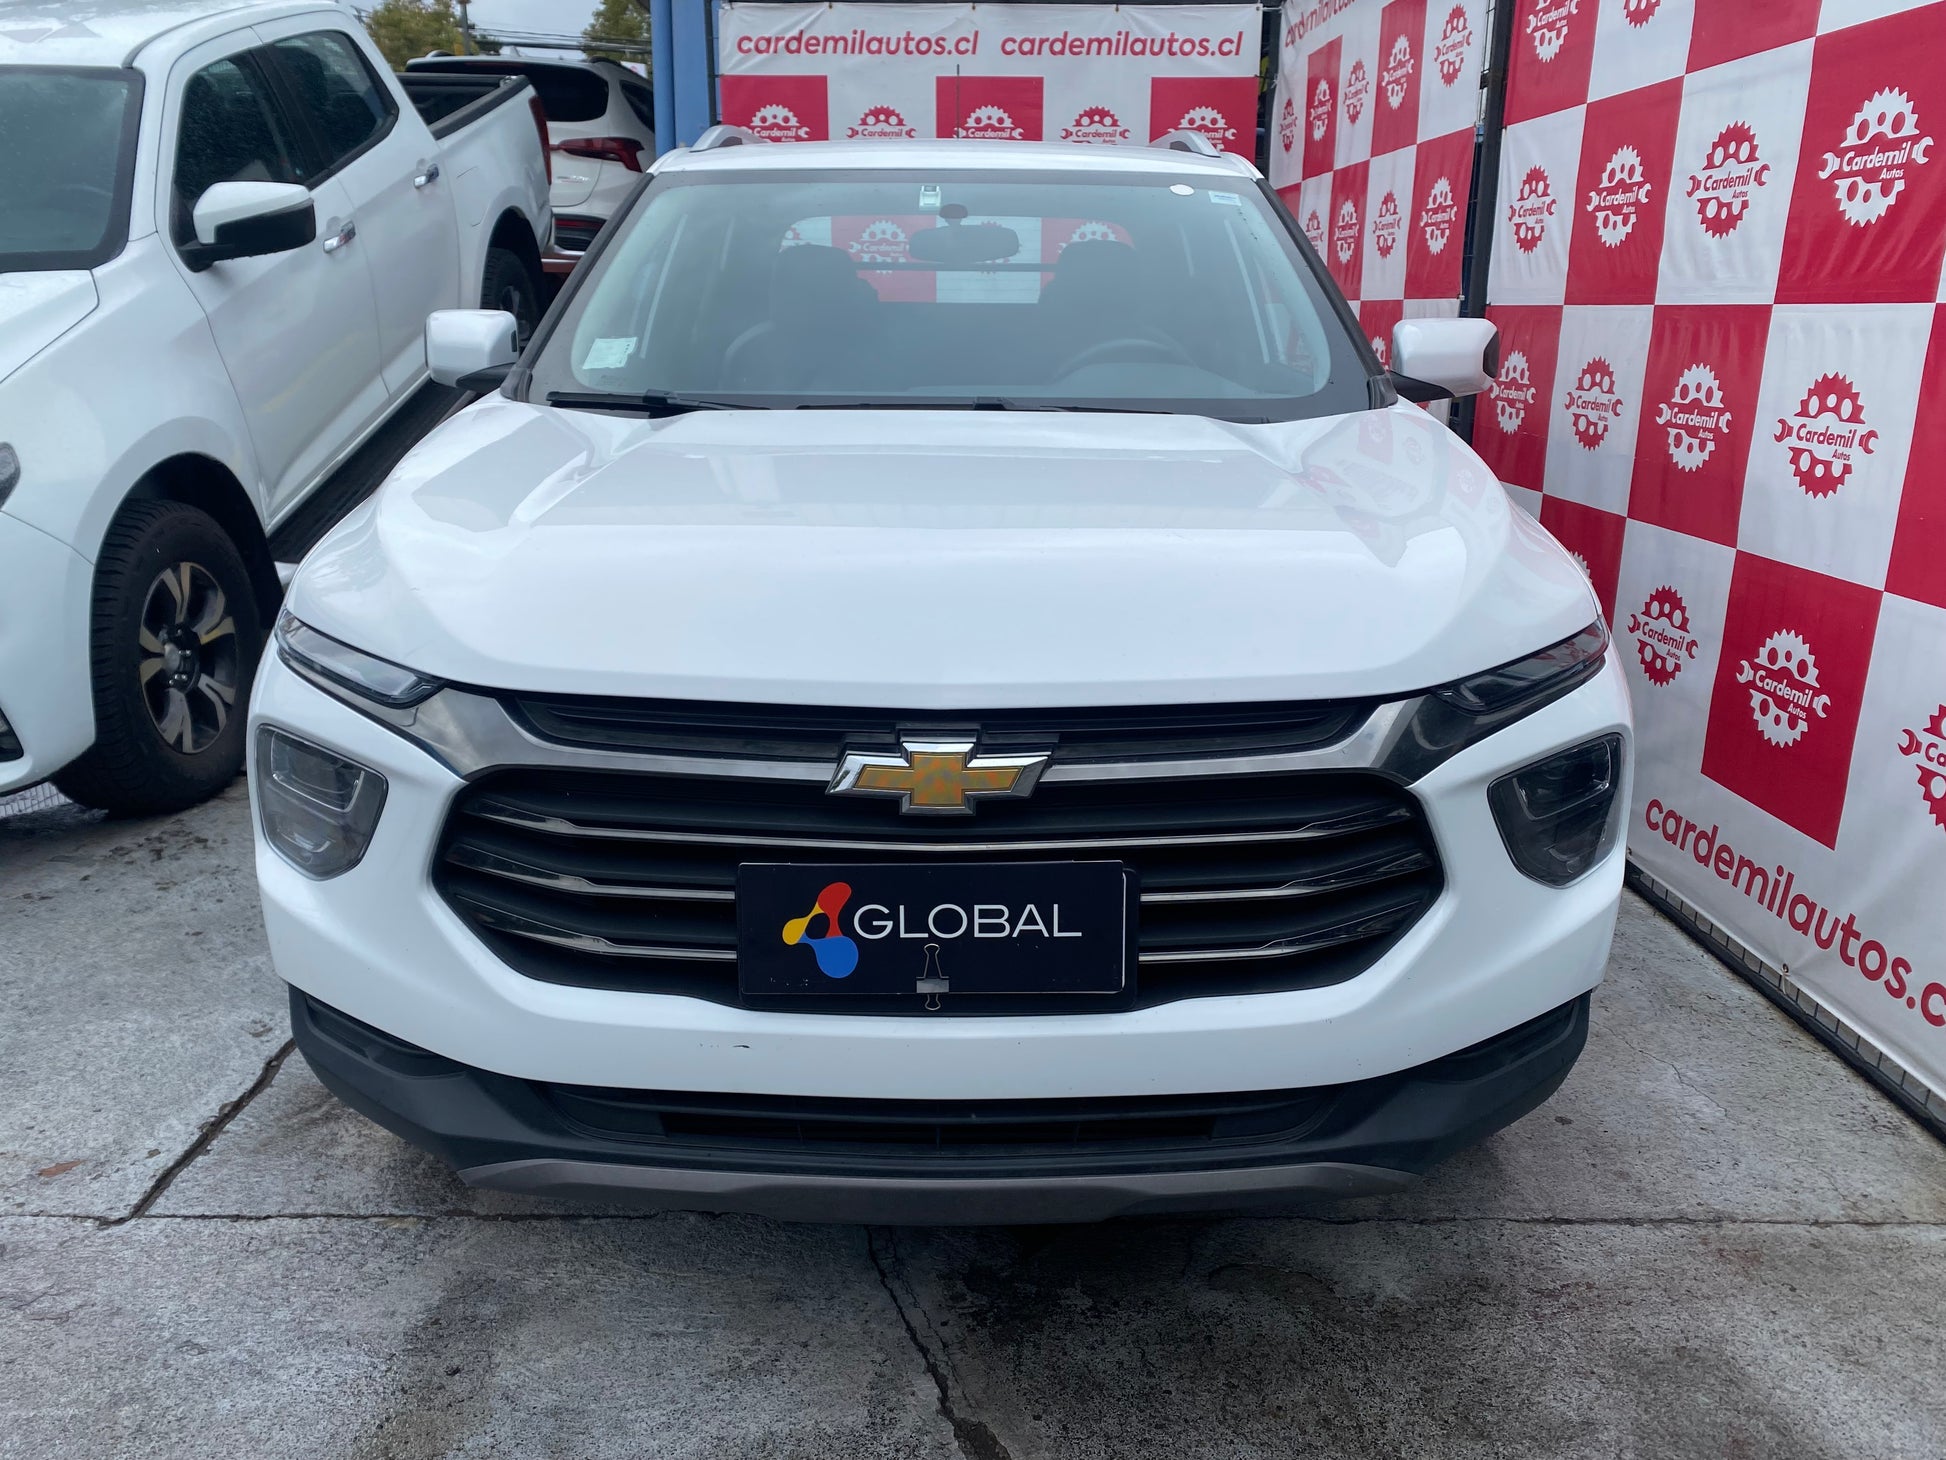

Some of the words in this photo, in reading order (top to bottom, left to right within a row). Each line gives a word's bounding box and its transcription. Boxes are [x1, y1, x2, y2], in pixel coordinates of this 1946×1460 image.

[736, 29, 979, 55] cardemilautos.cl
[1000, 30, 1244, 56] cardemilautos.cl
[753, 127, 796, 137] Cardemil
[861, 127, 902, 137] Cardemil
[968, 128, 1010, 138] Cardemil
[1075, 129, 1117, 139] Cardemil
[1842, 141, 1911, 171] Cardemil
[1703, 168, 1752, 191] Cardemil
[1879, 167, 1904, 180] Autos
[1601, 186, 1638, 207] Cardemil
[1732, 190, 1748, 199] Autos
[1518, 201, 1545, 218] Cardemil
[1500, 385, 1527, 400] Cardemil
[1576, 395, 1612, 413] Cardemil
[1671, 407, 1718, 428] Cardemil
[1698, 428, 1714, 439] Autos
[1796, 423, 1857, 449] Cardemil
[1832, 449, 1851, 461] Autos
[1642, 622, 1685, 652] Cardemil
[1666, 648, 1681, 662] Autos
[1755, 670, 1812, 708] Cardemil
[1787, 702, 1807, 719] Autos
[853, 903, 1082, 940] GLOBAL
